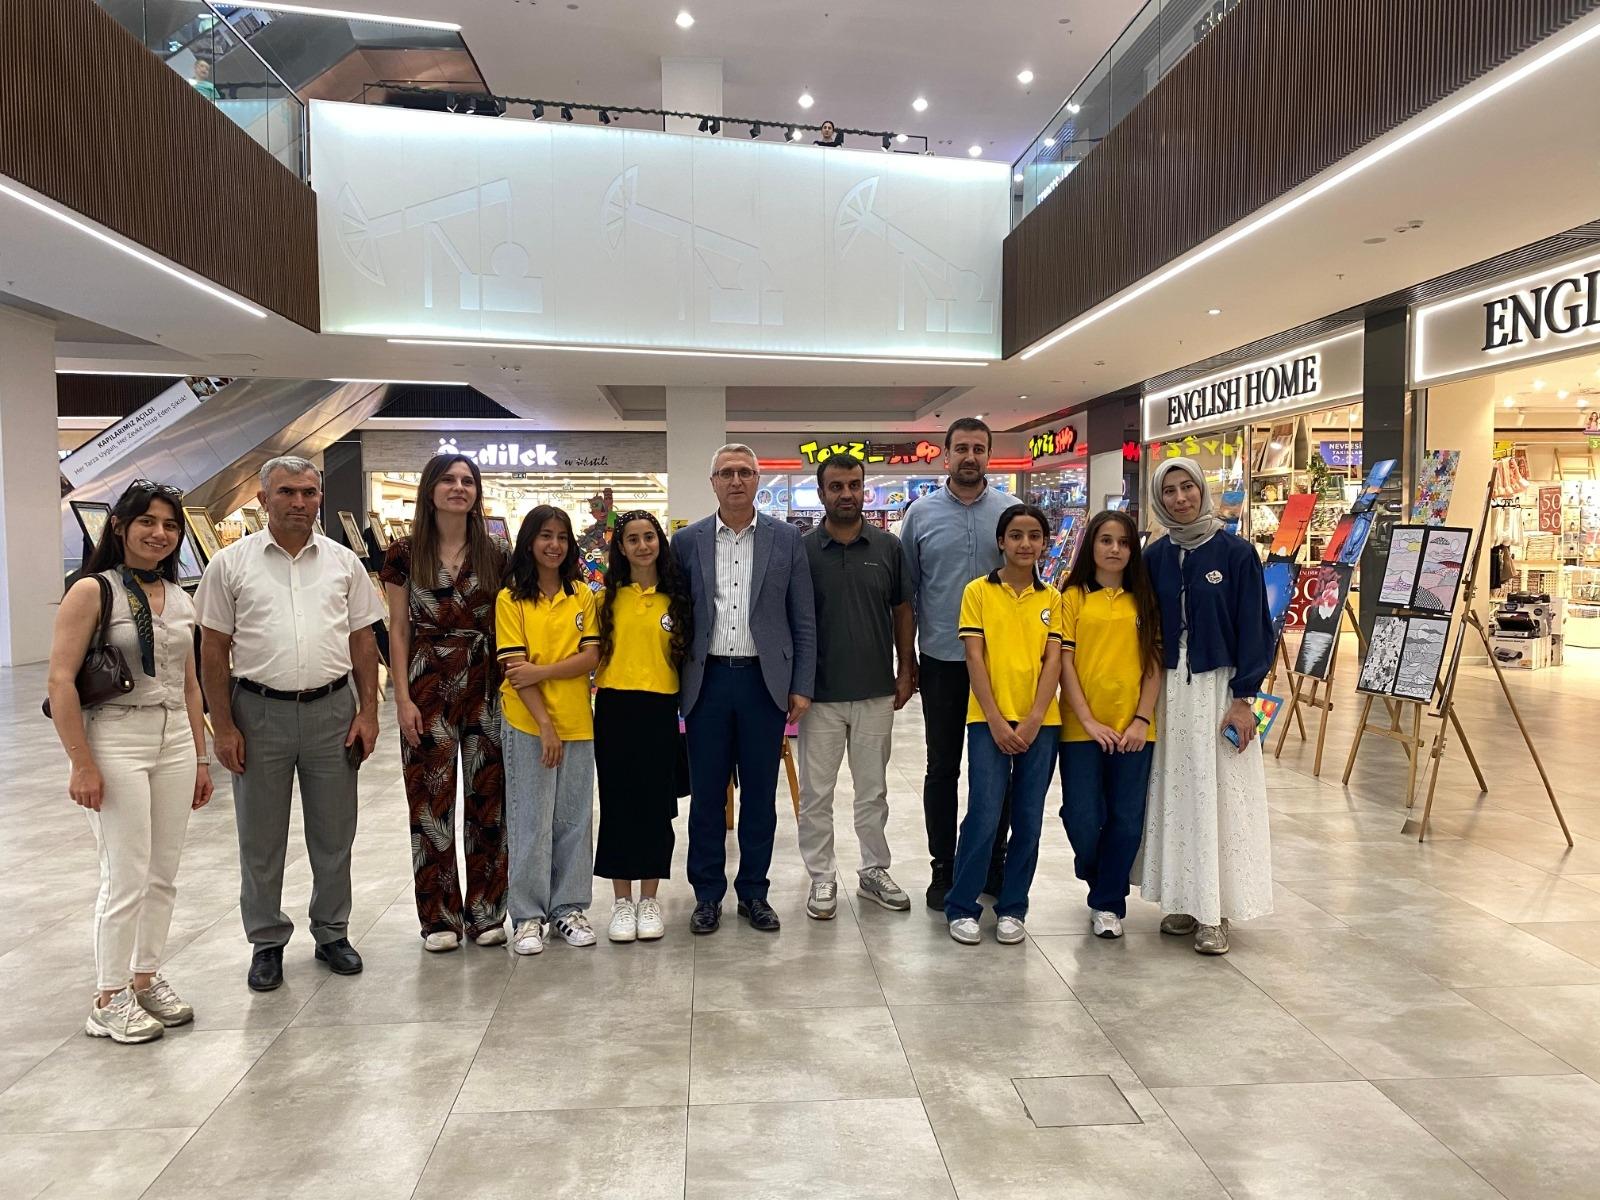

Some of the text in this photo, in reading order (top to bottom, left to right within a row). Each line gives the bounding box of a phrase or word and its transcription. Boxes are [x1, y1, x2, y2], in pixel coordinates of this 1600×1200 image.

[1168, 355, 1317, 426] ENGLISH HOME
[74, 465, 84, 475] Her
[84, 455, 100, 468] Tarza
[142, 415, 158, 428] Hitap
[157, 406, 171, 418] Eden
[97, 419, 136, 448] KAPILARIMIZ
[135, 406, 156, 423] AÇILDI
[1541, 494, 1561, 510] 50
[1541, 512, 1561, 529] 50
